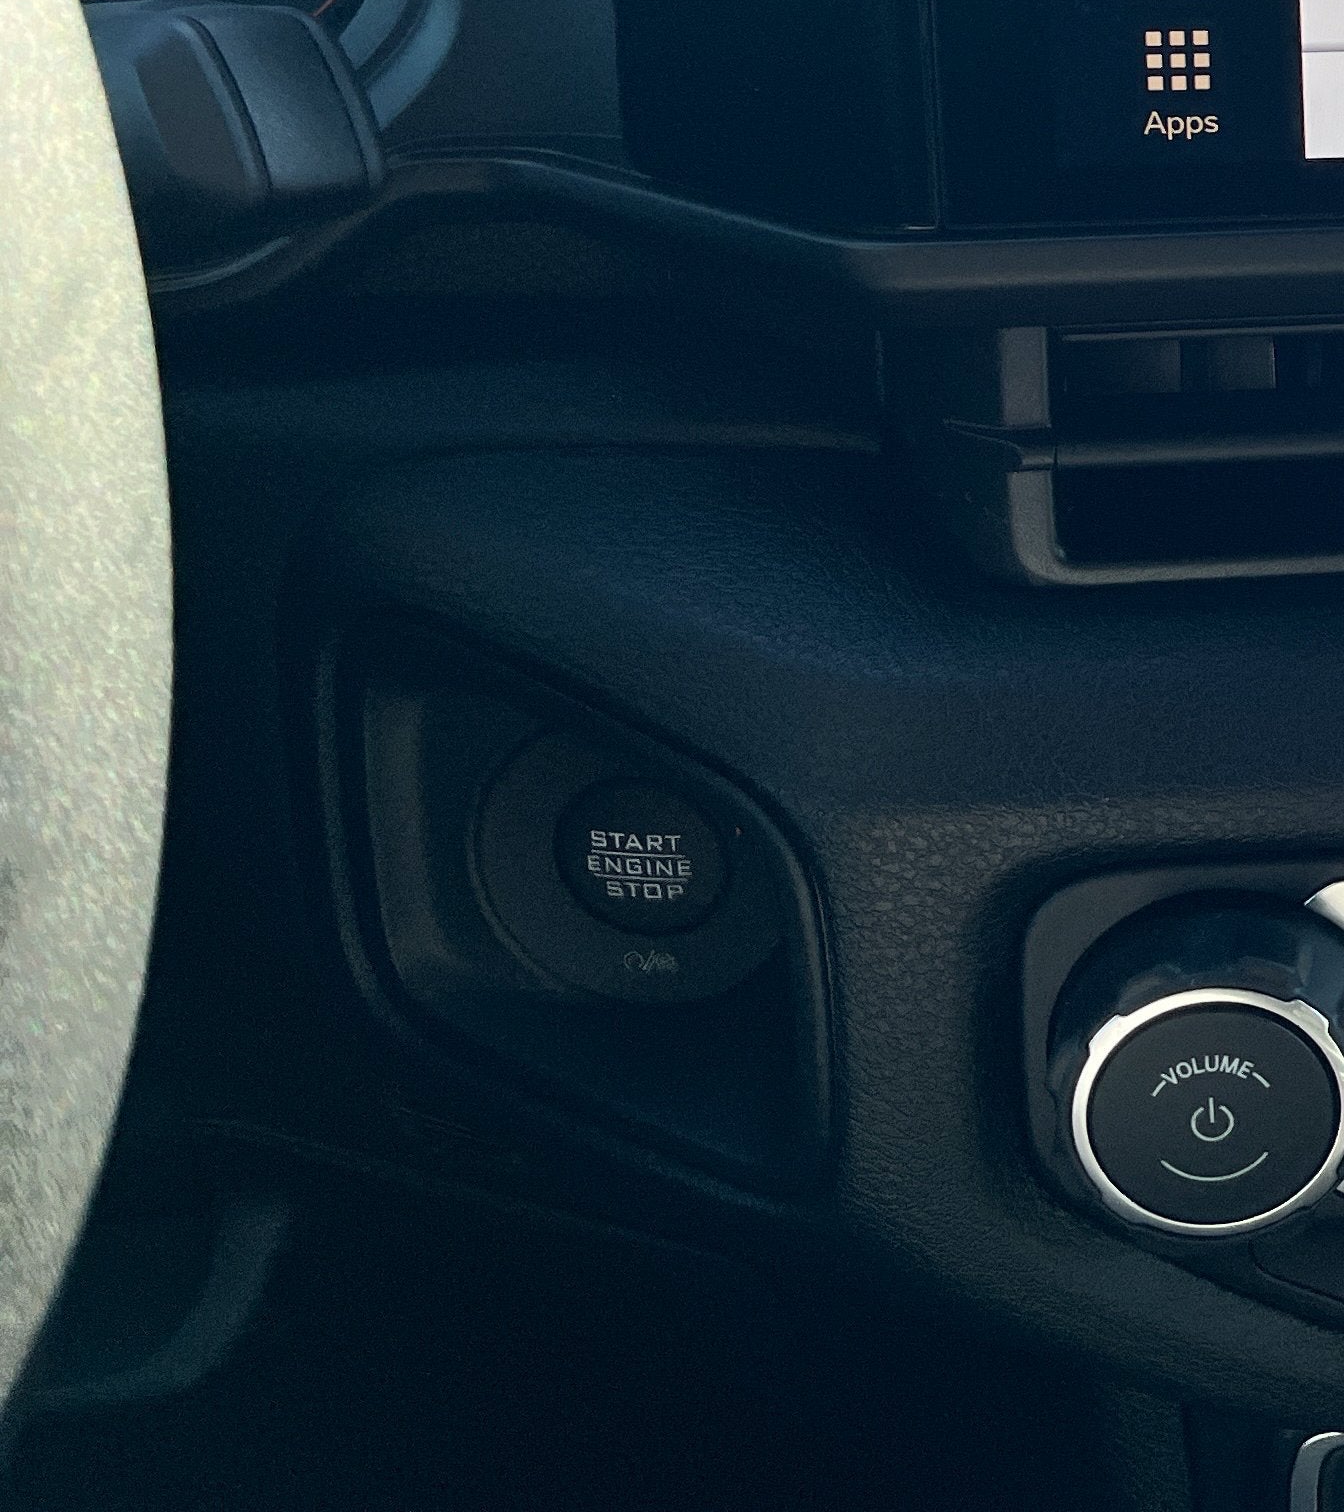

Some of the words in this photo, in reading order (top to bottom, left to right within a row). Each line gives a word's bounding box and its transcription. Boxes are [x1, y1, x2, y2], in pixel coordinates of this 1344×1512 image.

[1144, 111, 1219, 141] Apps
[590, 829, 681, 853] START
[587, 854, 693, 877] ENGINE
[606, 881, 683, 900] STOP
[1160, 1054, 1255, 1085] VOLUME
